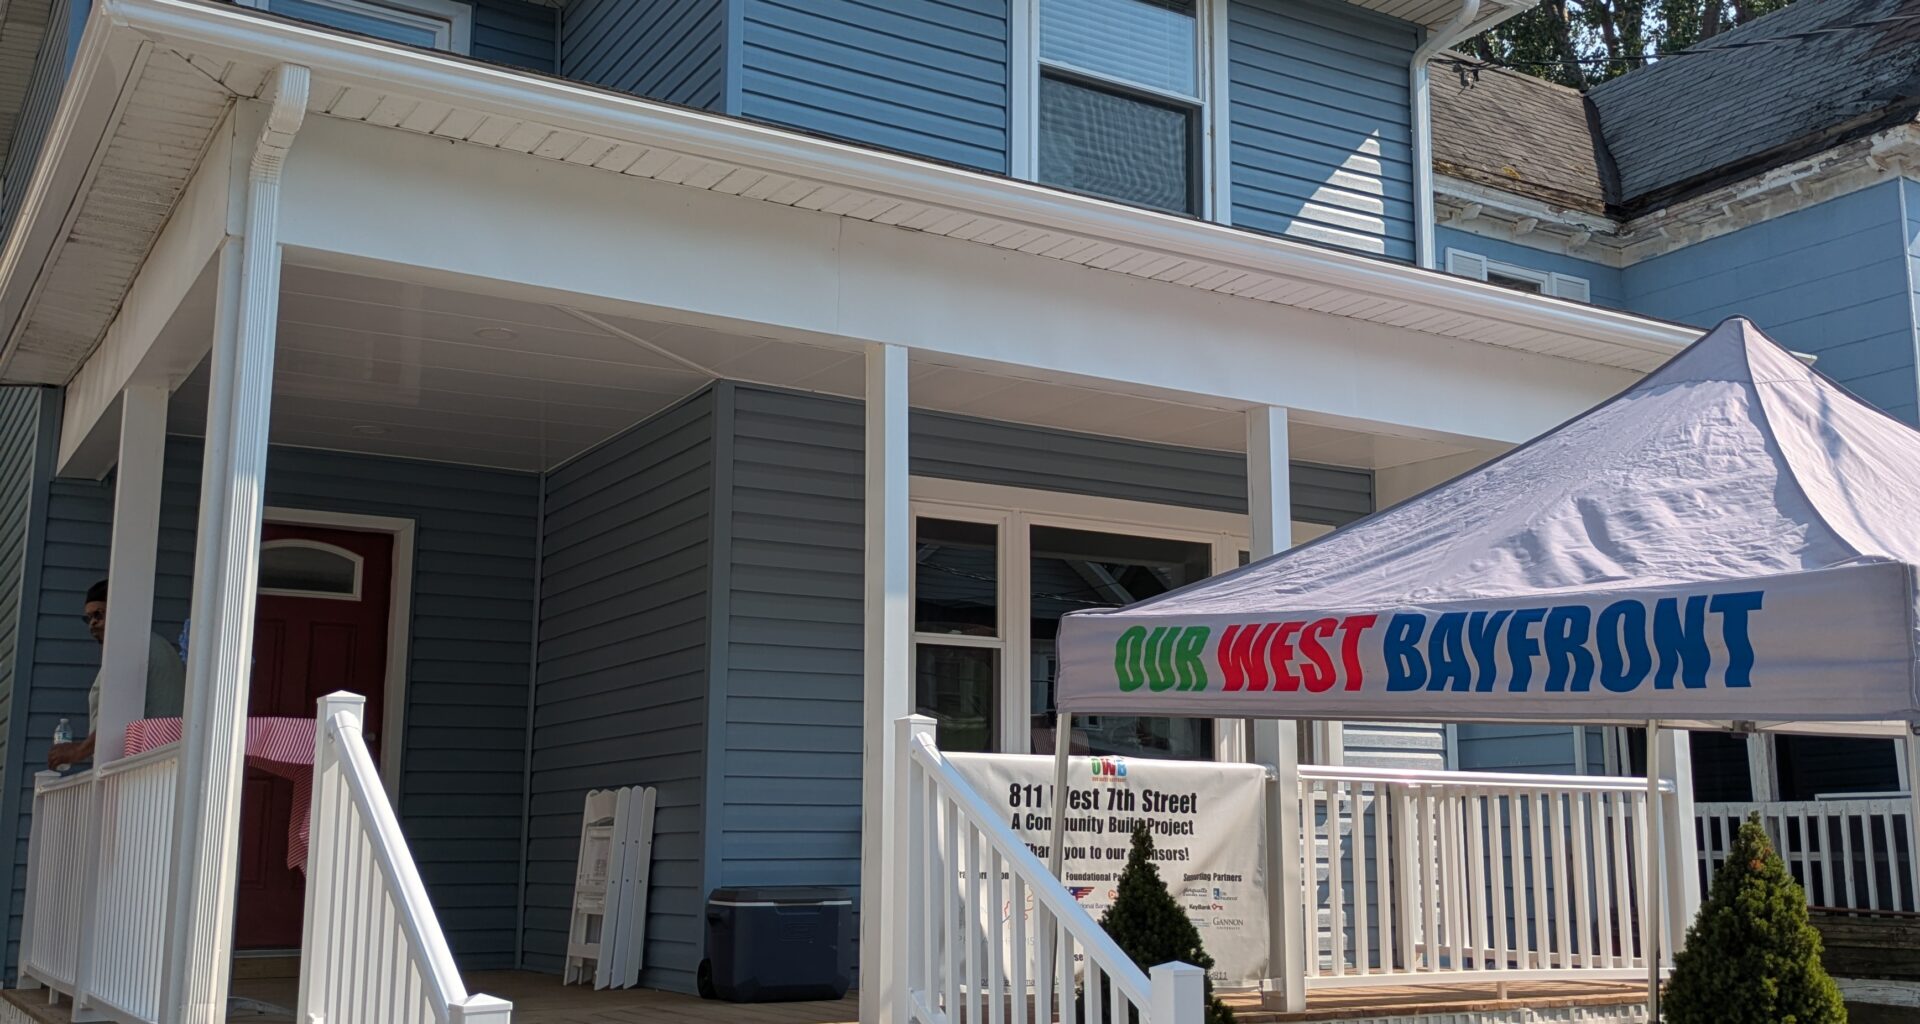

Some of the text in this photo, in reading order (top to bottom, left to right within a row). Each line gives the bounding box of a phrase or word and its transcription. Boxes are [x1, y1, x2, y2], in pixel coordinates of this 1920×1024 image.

[1114, 590, 1764, 692] OUR WEST BAYFRONT
[1009, 783, 1042, 808] 811
[1106, 788, 1135, 811] 7th
[1142, 789, 1197, 814] Street
[1011, 813, 1020, 830] A
[1147, 818, 1194, 836] Project
[1064, 846, 1086, 860] you
[1090, 846, 1102, 859] to
[1106, 848, 1126, 860] our
[1066, 872, 1111, 881] Foundational
[1212, 873, 1242, 882] Partners
[1213, 917, 1243, 926] GANNON
